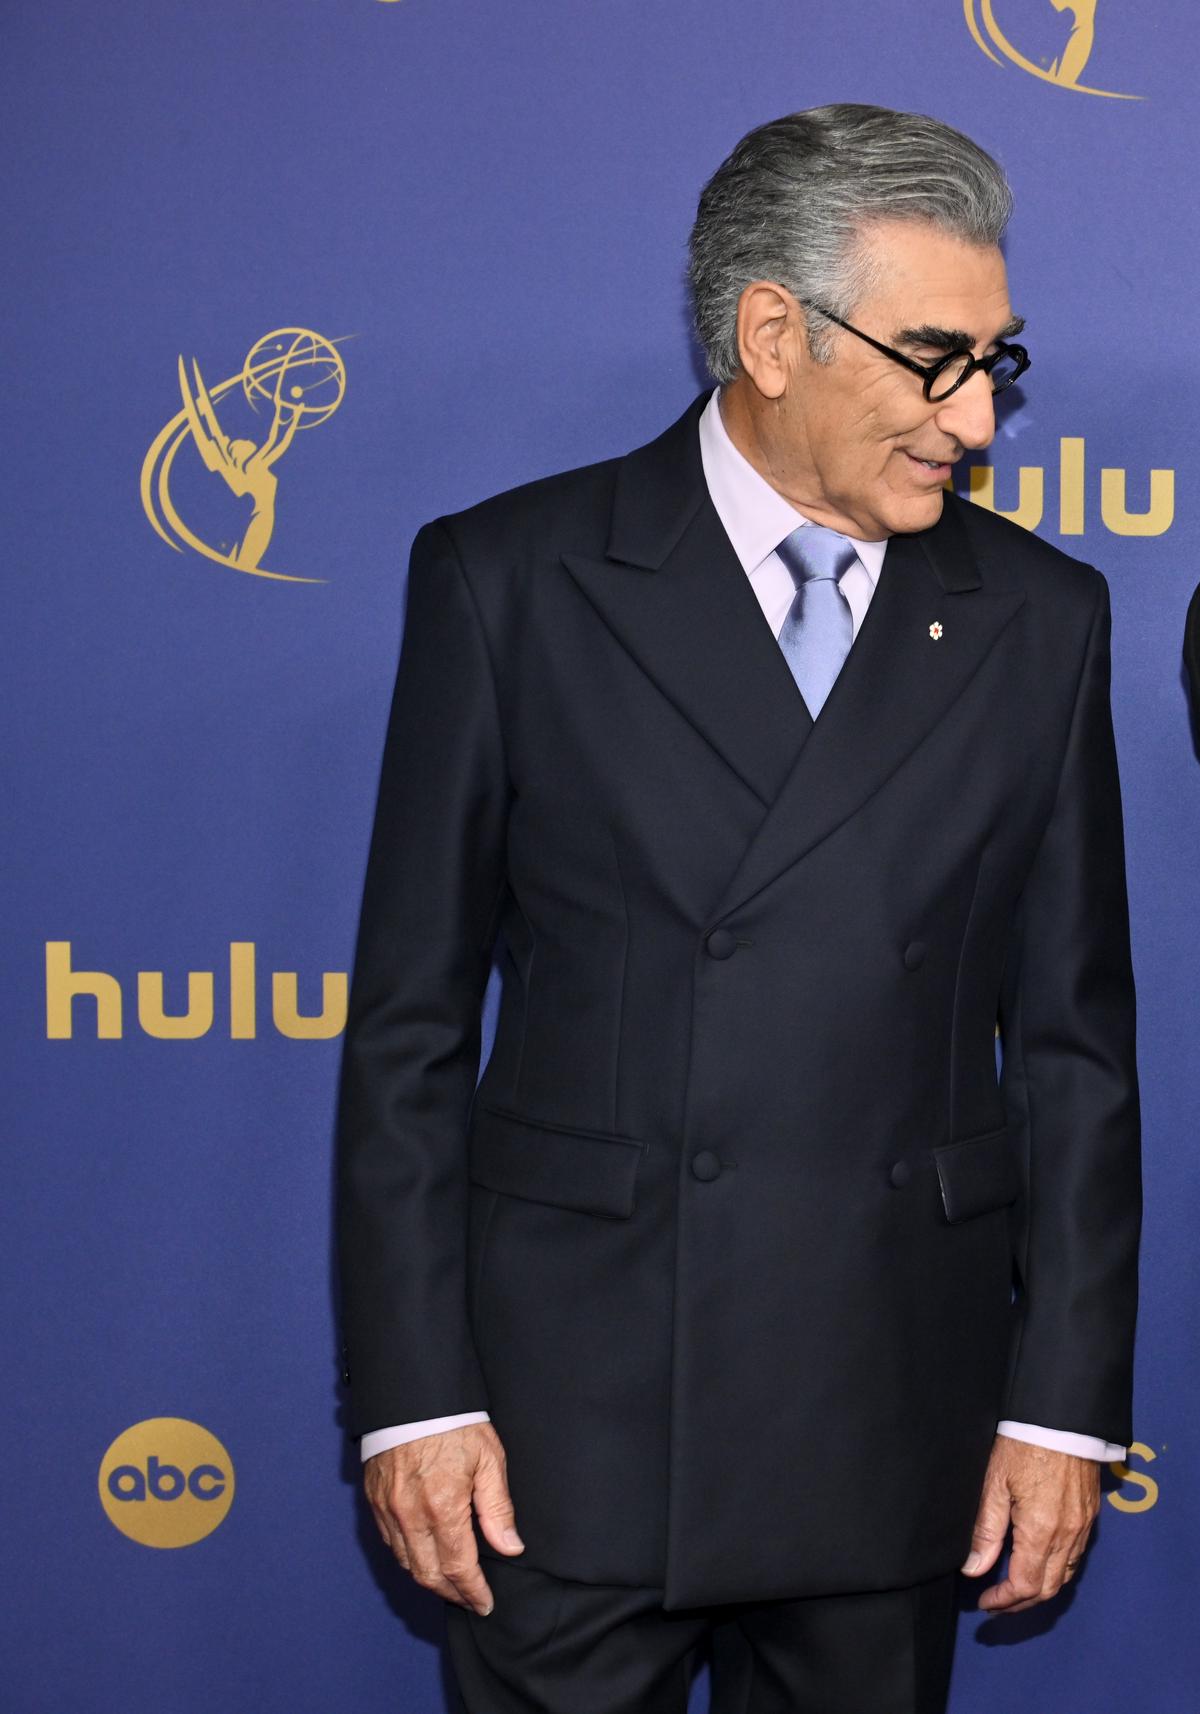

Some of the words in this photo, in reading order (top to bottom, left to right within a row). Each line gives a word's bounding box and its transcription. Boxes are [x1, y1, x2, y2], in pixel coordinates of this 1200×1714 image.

[946, 437, 1175, 536] ulu
[46, 941, 348, 1040] hulu
[107, 1455, 226, 1502] abc
